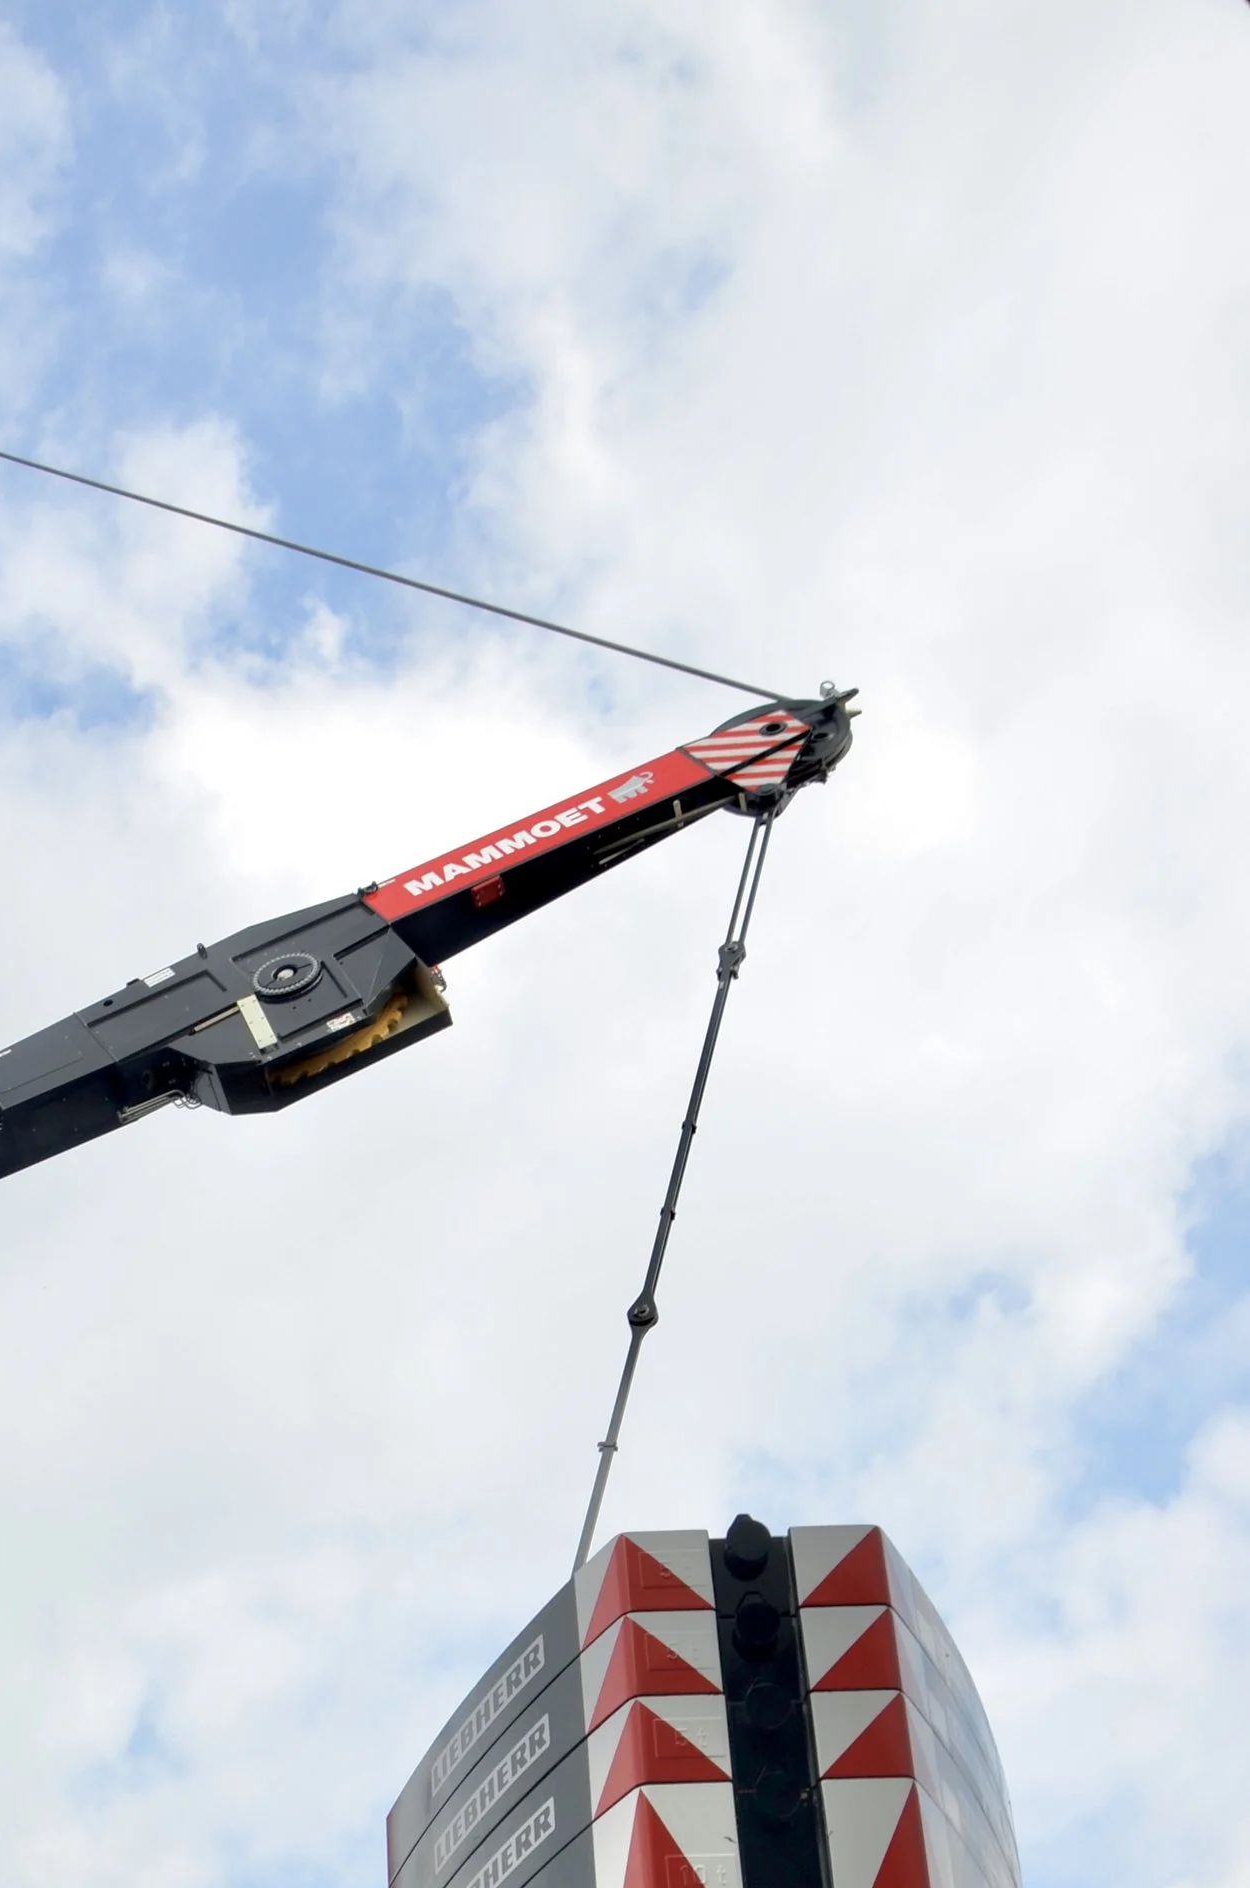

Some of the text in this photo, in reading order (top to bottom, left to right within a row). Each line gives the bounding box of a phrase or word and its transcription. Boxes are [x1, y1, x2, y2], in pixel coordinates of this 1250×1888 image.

[403, 796, 606, 896] MAMMOET
[433, 1637, 544, 1794] LIEBHERR
[436, 1717, 550, 1872] LIEBHERR
